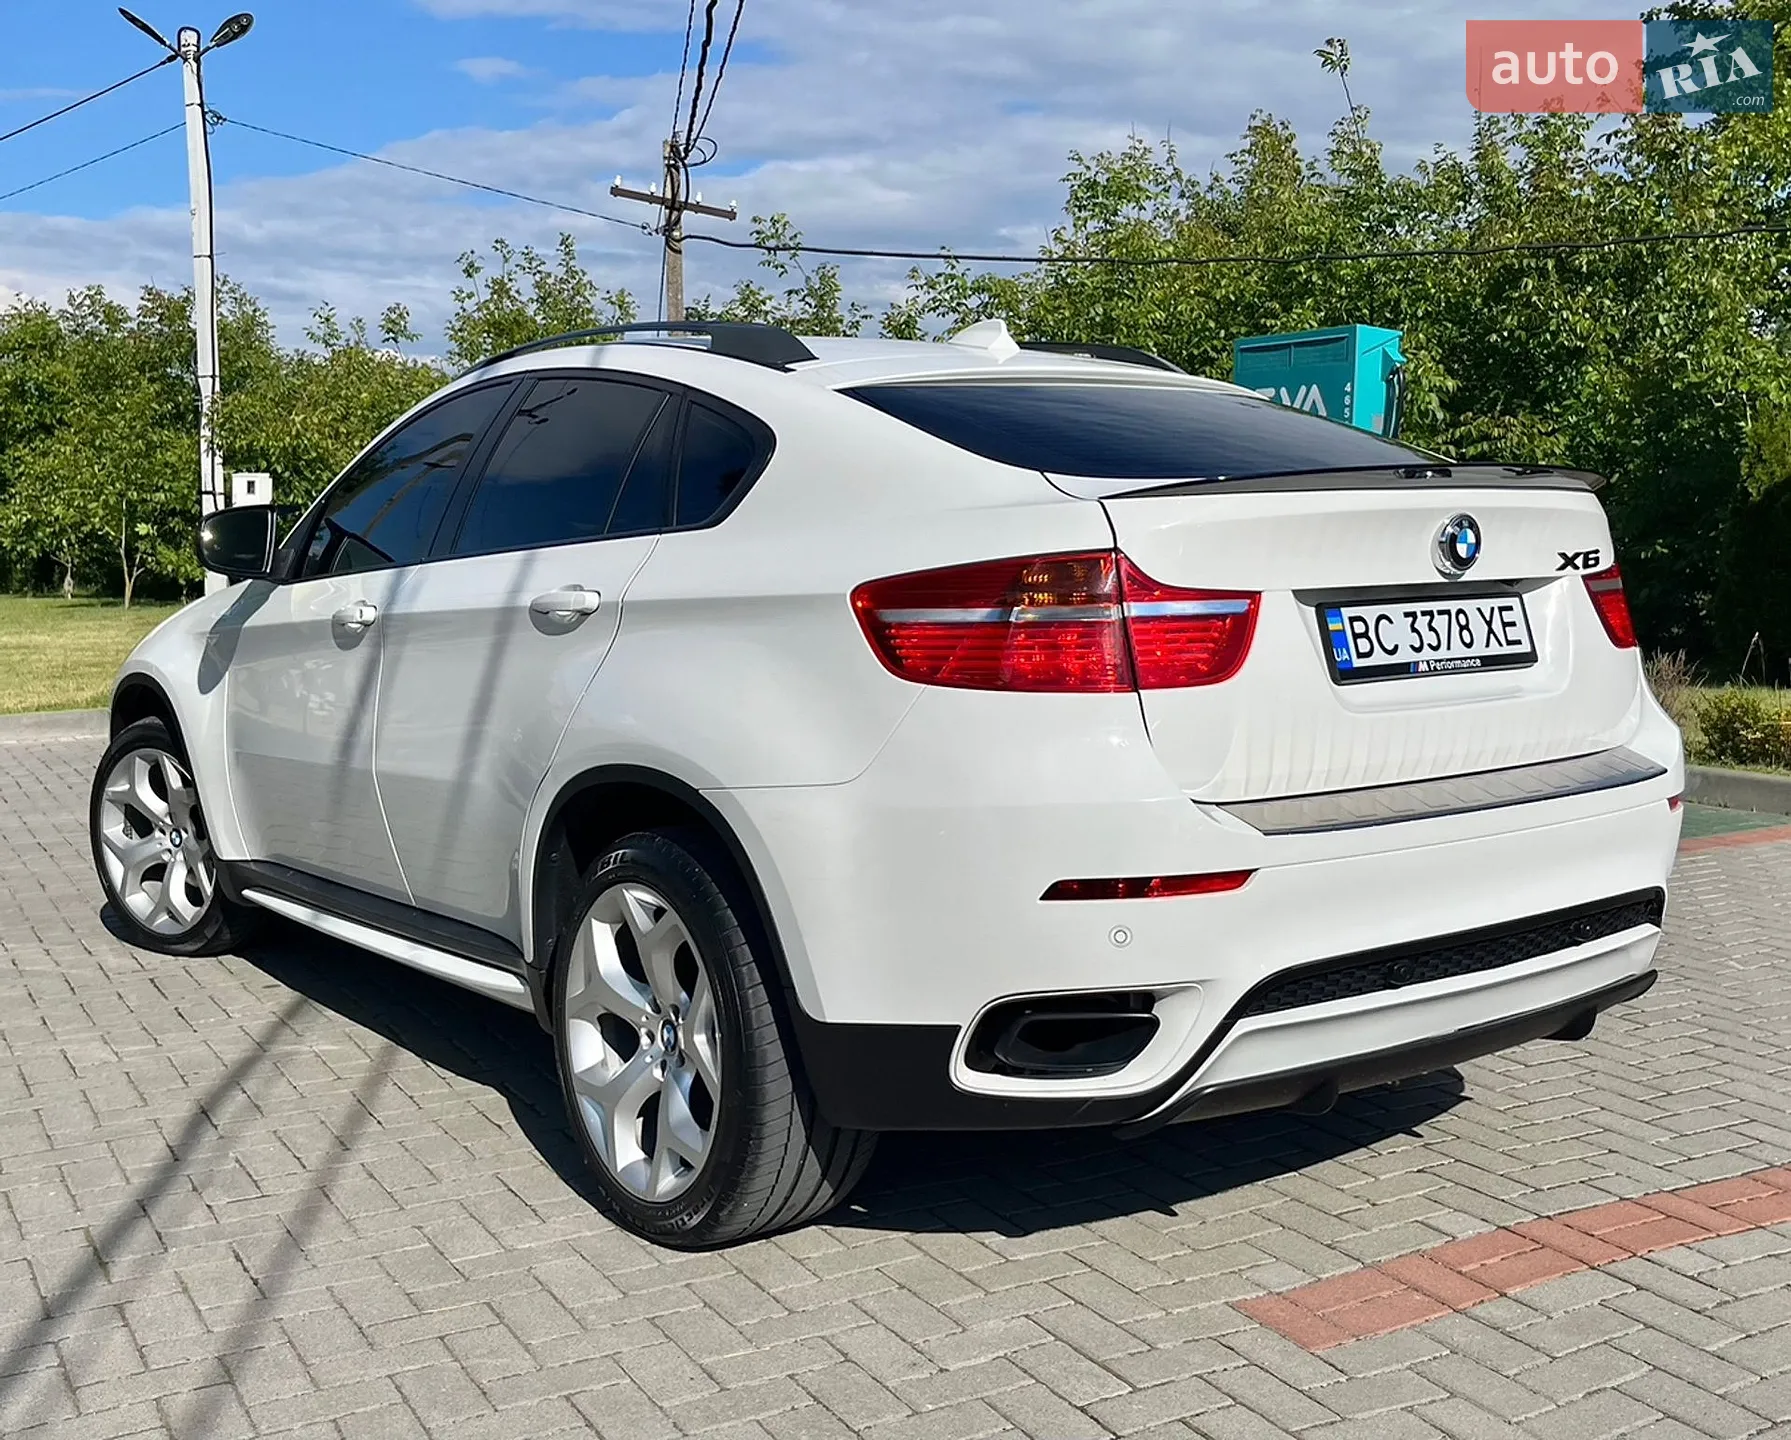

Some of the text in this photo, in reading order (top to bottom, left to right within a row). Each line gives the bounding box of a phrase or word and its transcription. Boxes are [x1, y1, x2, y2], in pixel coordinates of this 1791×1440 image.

[1255, 383, 1327, 417] VA
[1343, 382, 1352, 424] 465
[1555, 549, 1600, 571] X6
[1347, 605, 1523, 659] BC 3378 XE
[1333, 648, 1350, 662] UA
[1429, 658, 1482, 671] Performance
